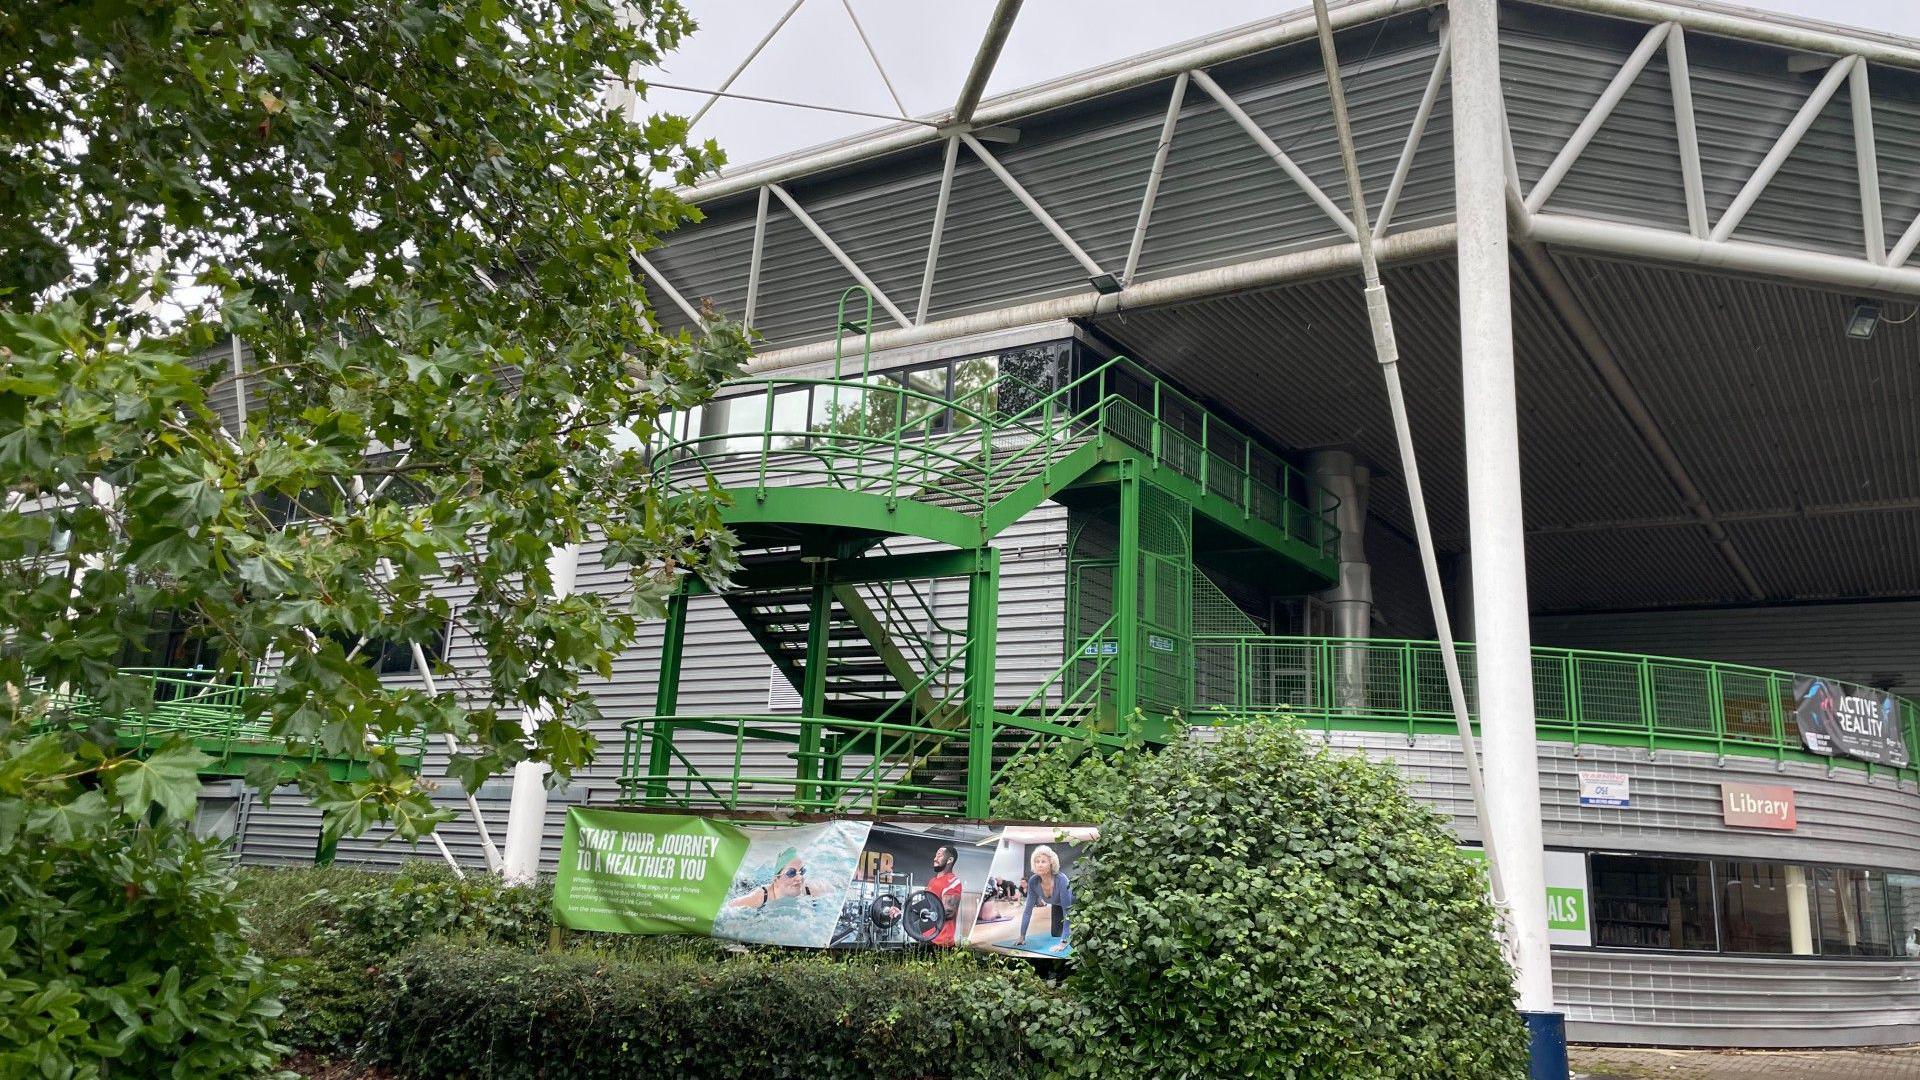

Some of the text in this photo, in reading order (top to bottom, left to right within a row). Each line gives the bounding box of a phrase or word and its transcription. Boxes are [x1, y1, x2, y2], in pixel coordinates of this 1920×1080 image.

[1839, 695, 1879, 719] ACTIVE
[1836, 711, 1883, 737] REALITY
[1729, 792, 1789, 820] Library
[578, 827, 720, 858] START YOUR JOURNEY
[576, 850, 707, 881] TO A HEALTHIER YOU
